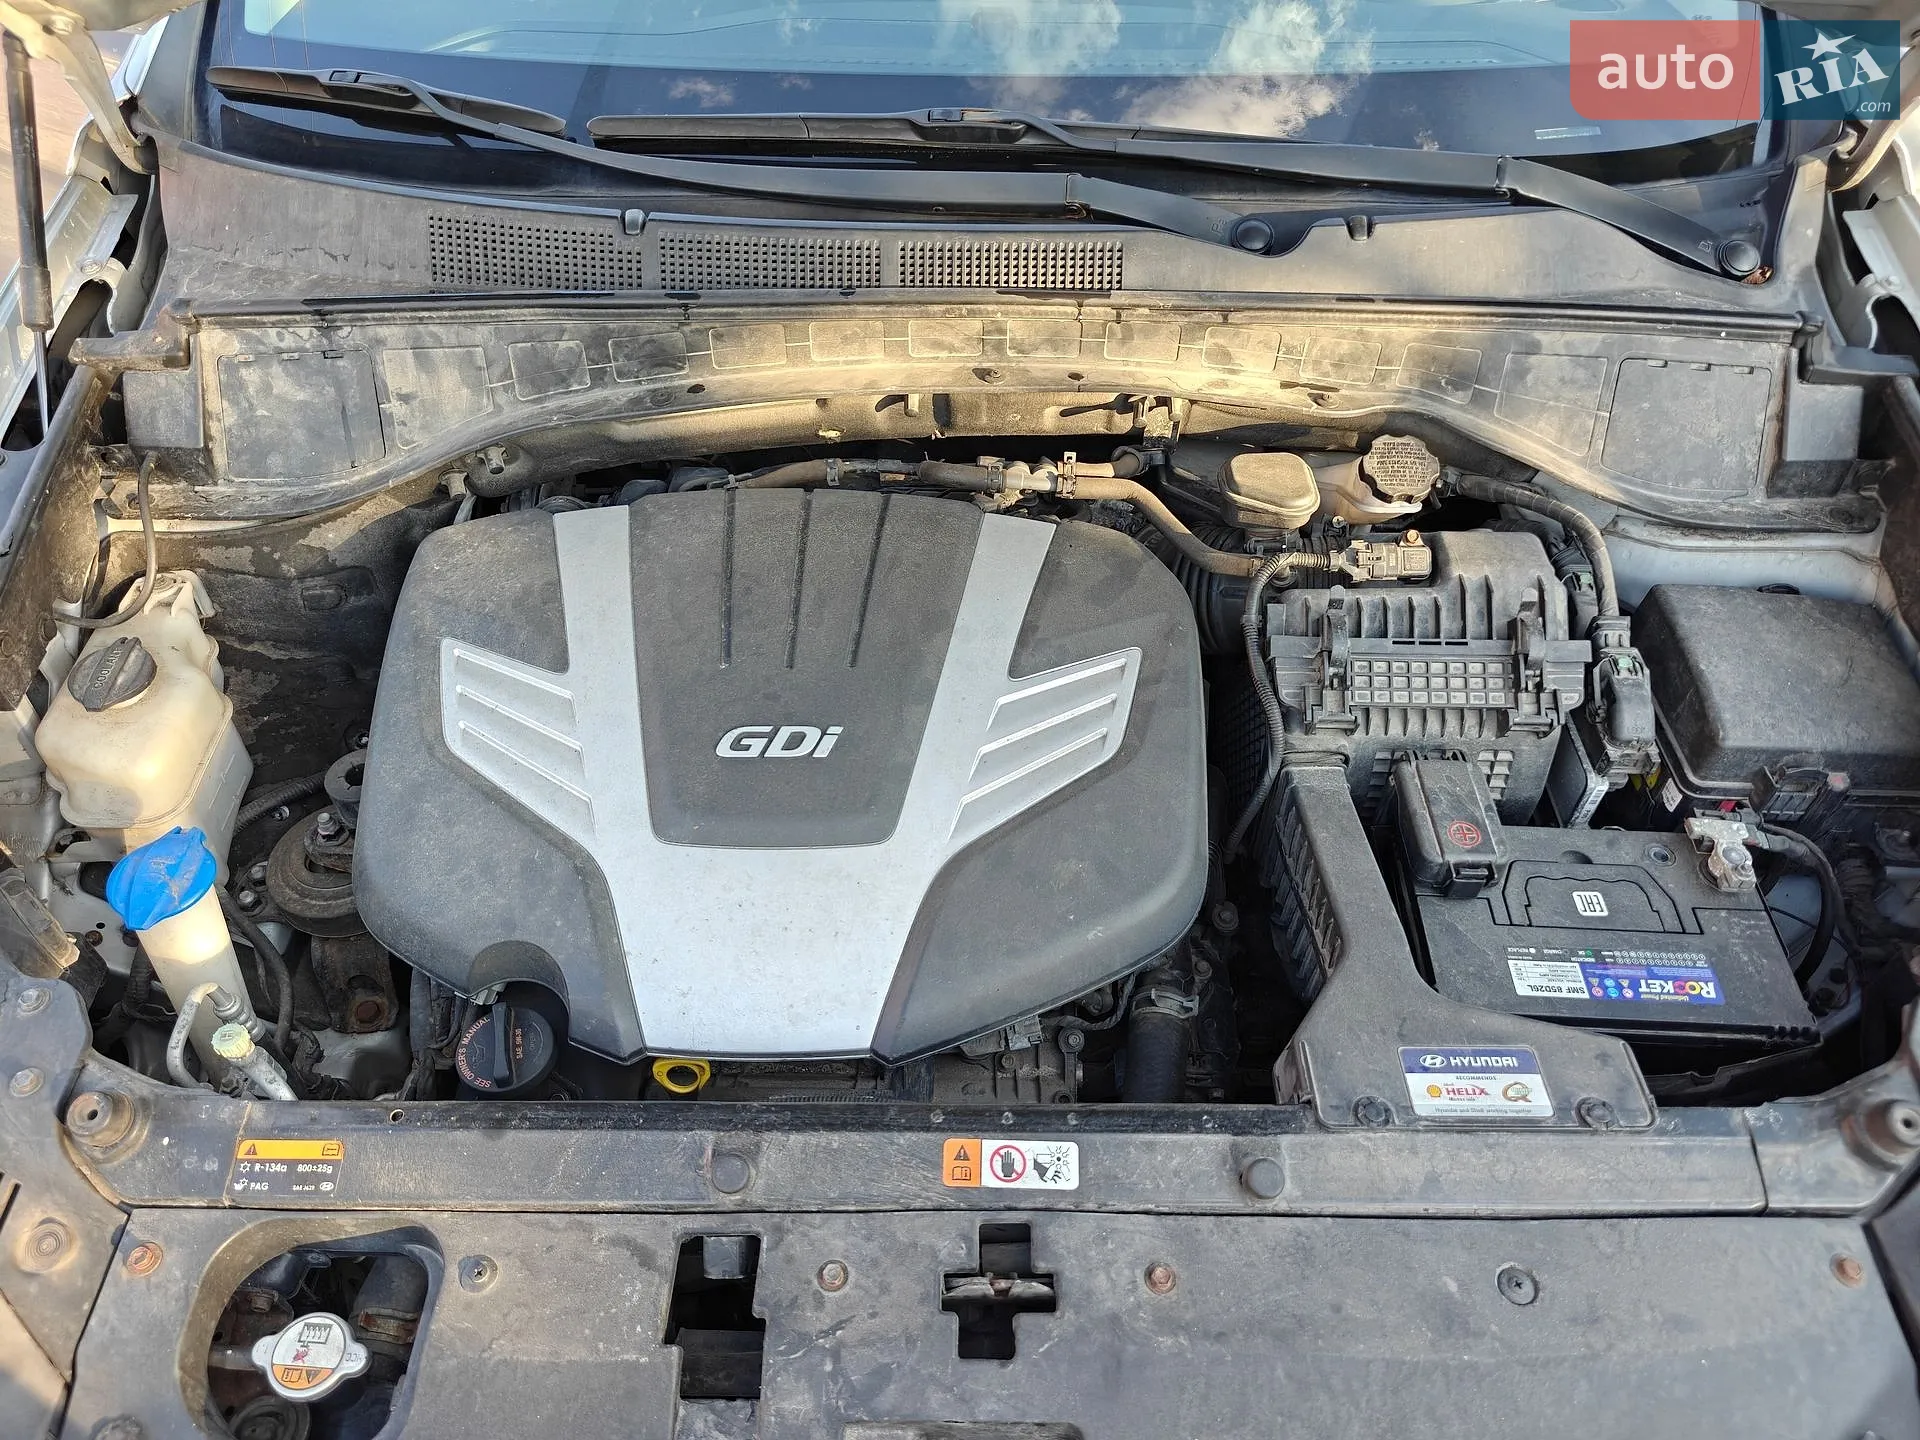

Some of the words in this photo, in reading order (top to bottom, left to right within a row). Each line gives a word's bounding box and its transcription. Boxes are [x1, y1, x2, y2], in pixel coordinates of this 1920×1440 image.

[715, 725, 844, 758] GDi
[1566, 986, 1586, 994] SMF
[1638, 979, 1717, 999] ROCKET
[461, 1017, 491, 1045] MANUAL
[1450, 1056, 1519, 1068] HYUNDAI
[474, 1077, 492, 1088] SEE
[1445, 1087, 1489, 1096] HELIX
[254, 1163, 288, 1172] R-134a
[249, 1182, 269, 1190] PAG
